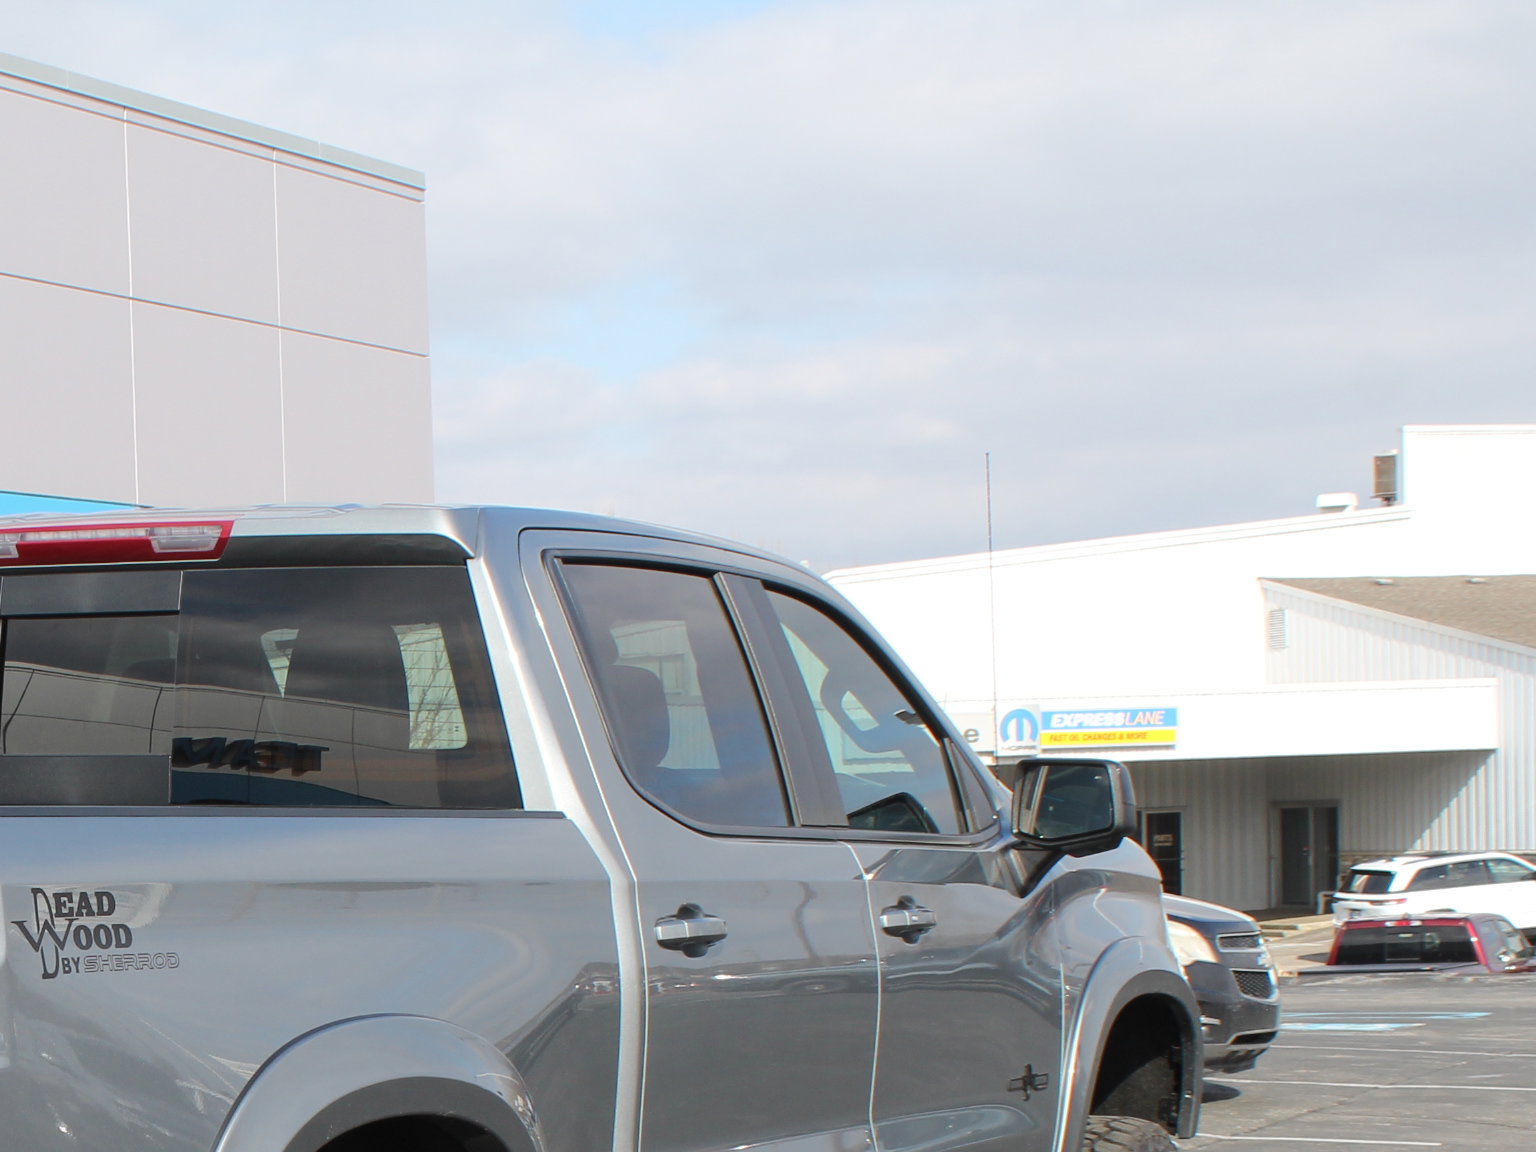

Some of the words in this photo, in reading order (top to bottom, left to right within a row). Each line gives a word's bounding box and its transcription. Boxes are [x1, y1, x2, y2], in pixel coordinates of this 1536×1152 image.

[1049, 733, 1066, 742] FAST
[11, 917, 133, 952] WOOD
[61, 957, 81, 974] BY
[84, 952, 180, 973] SHERROD
